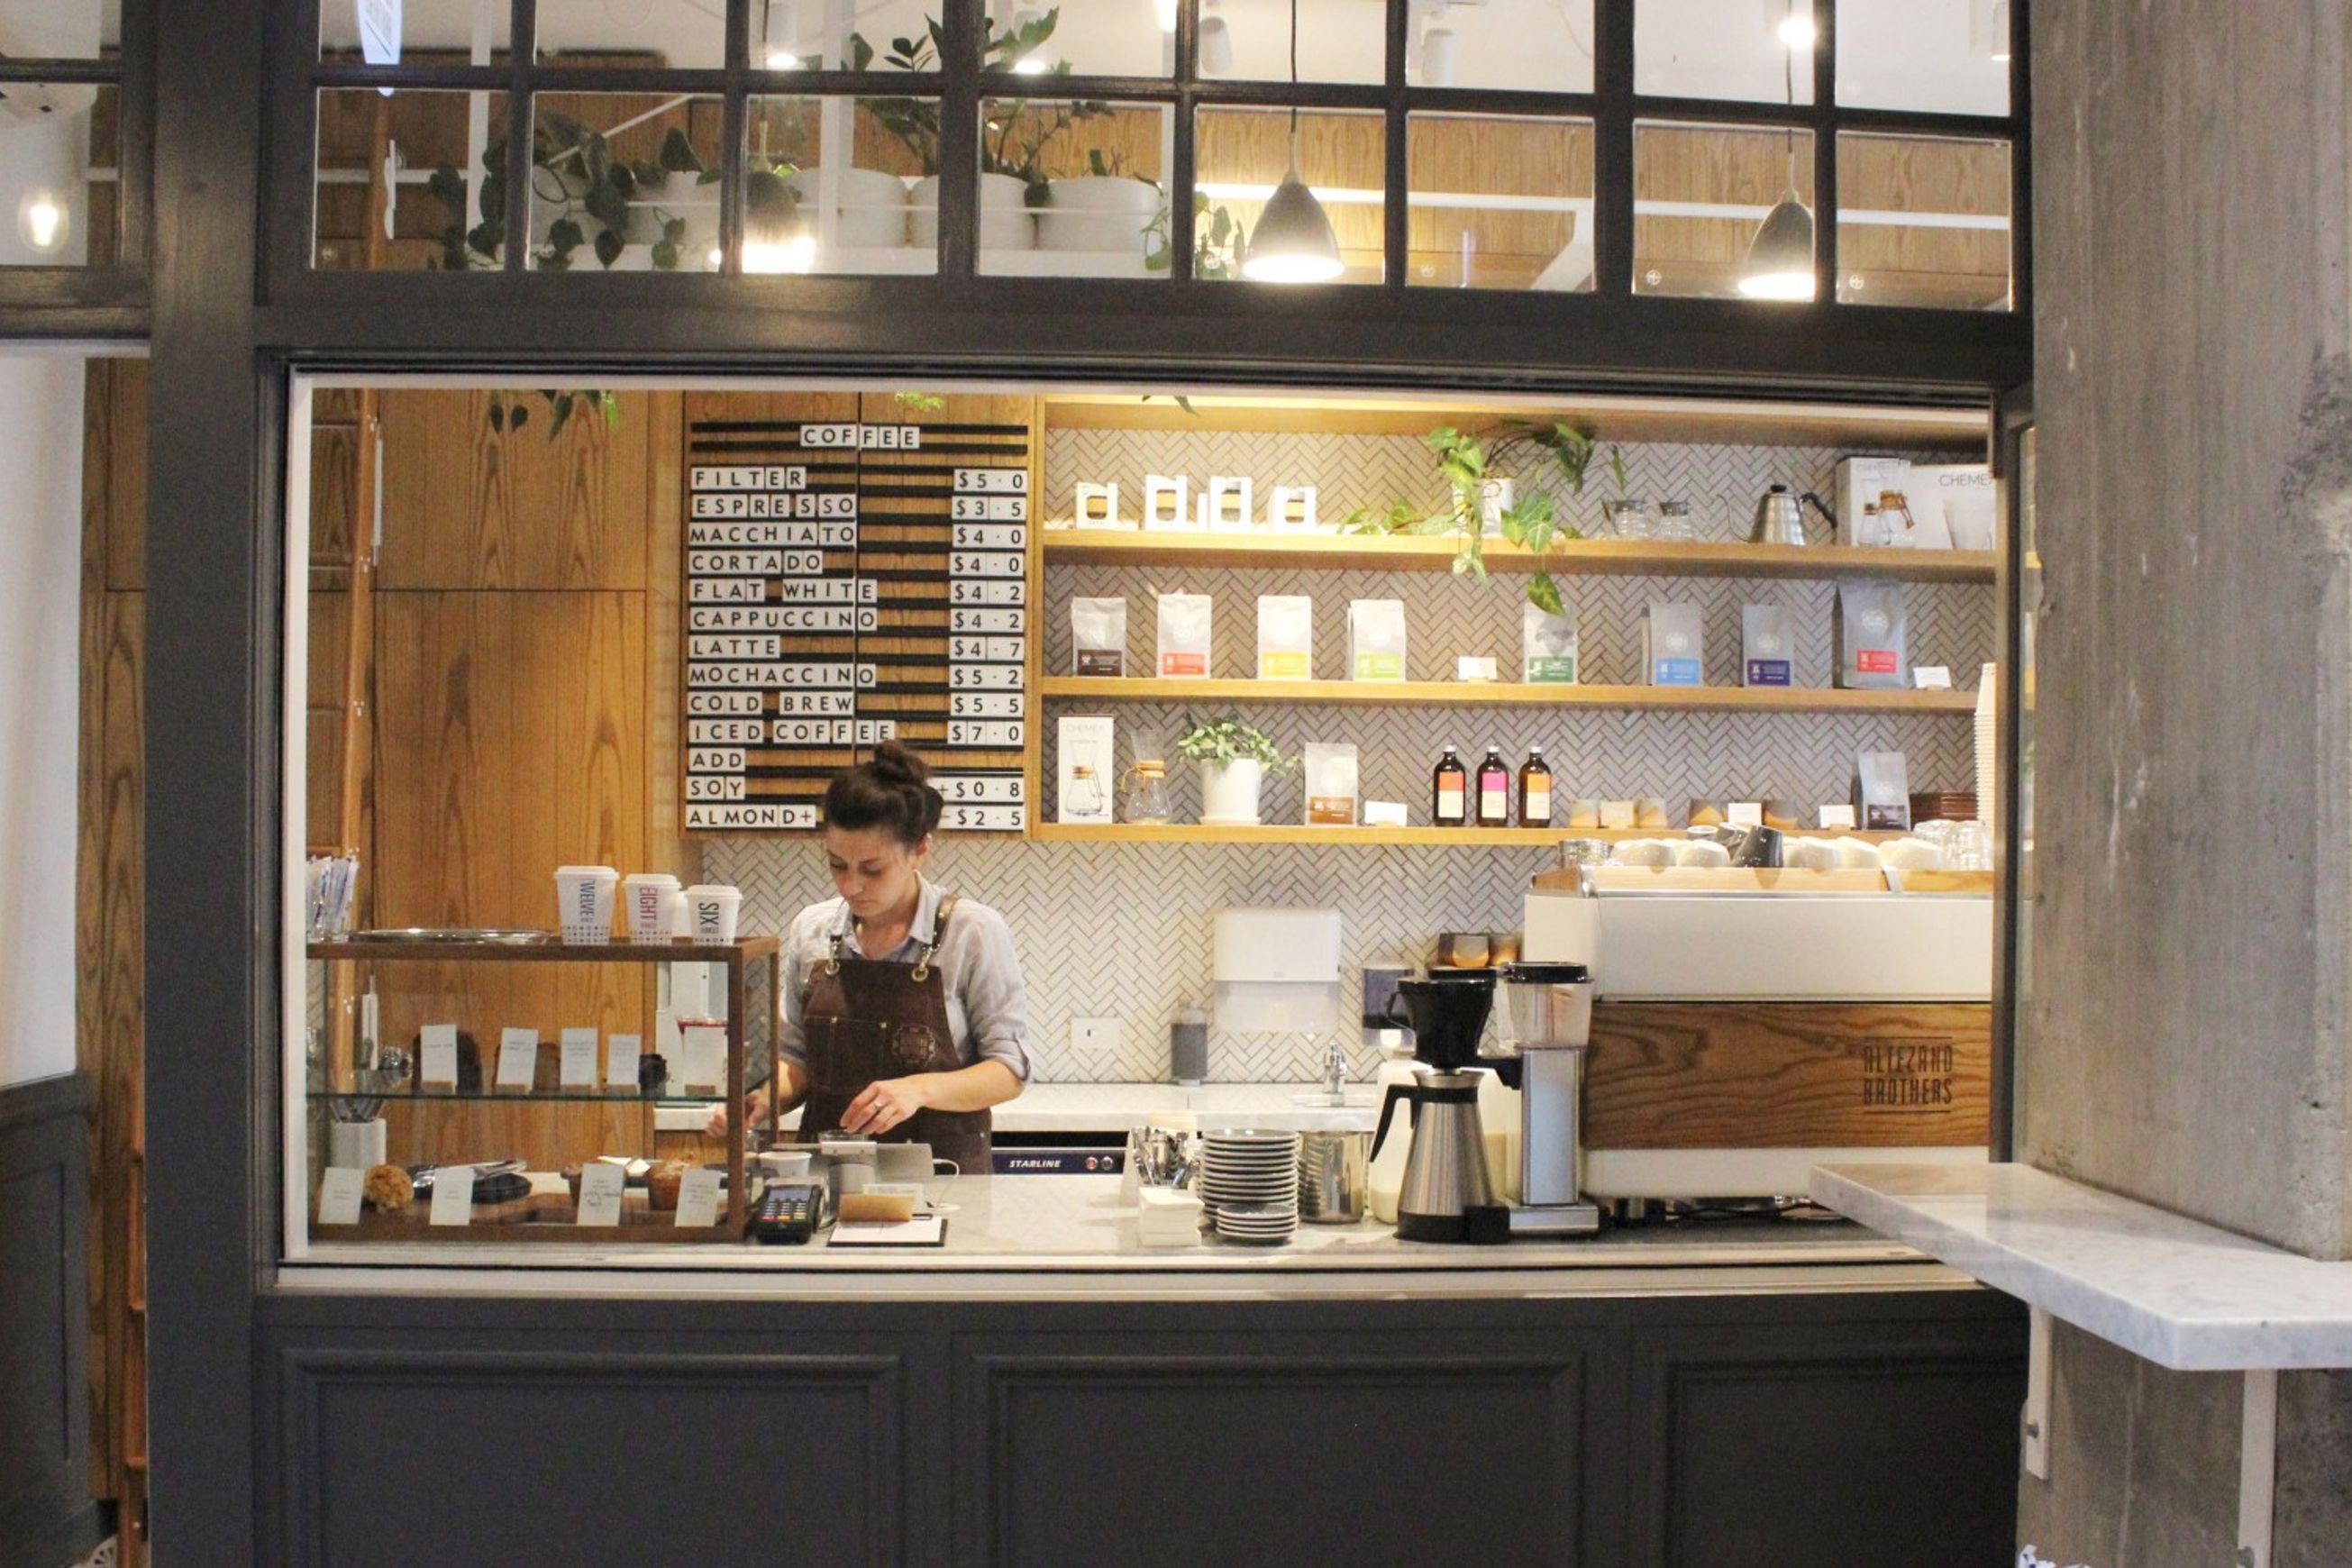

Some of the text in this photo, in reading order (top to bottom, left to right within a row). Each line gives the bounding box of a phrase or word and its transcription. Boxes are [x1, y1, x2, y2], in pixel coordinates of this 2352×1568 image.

[804, 428, 915, 445] COFFEE
[696, 471, 801, 486] FILTER
[697, 497, 852, 514] ESPRESSO
[691, 526, 854, 542] MACCHIATO
[693, 555, 820, 570] CORTADO
[694, 584, 761, 597] FLAT
[784, 583, 871, 598] WHITE
[694, 611, 875, 627] CAPPUCCINO
[694, 639, 776, 654] LATTE
[690, 668, 873, 684] MOCHACCINO
[691, 696, 760, 711] COLD
[784, 697, 852, 711] BREW
[696, 725, 761, 739] ICED
[776, 725, 889, 740] COFFEE
[693, 752, 742, 768] ADD
[691, 780, 741, 796] SOY
[640, 888, 658, 920] EIGHT
[698, 902, 720, 925] SIX
[1864, 1078, 1953, 1104] BROTHERS
[1009, 1160, 1062, 1168] STARLINE
